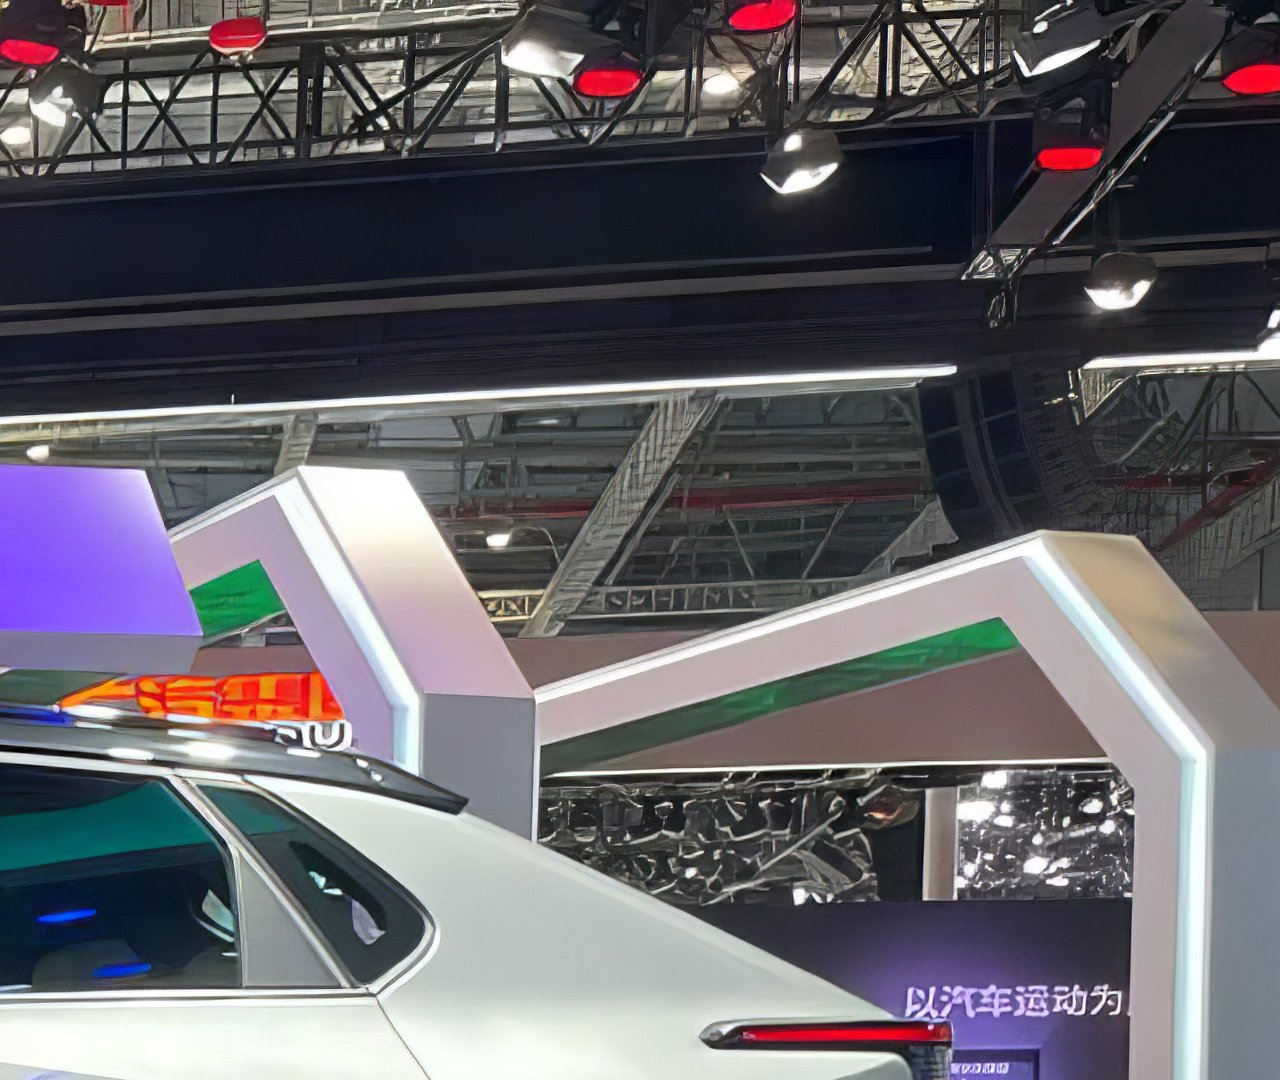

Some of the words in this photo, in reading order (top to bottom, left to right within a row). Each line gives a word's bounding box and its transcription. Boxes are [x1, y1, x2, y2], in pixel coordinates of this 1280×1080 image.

[904, 984, 1131, 1019] 以汽车运动为
